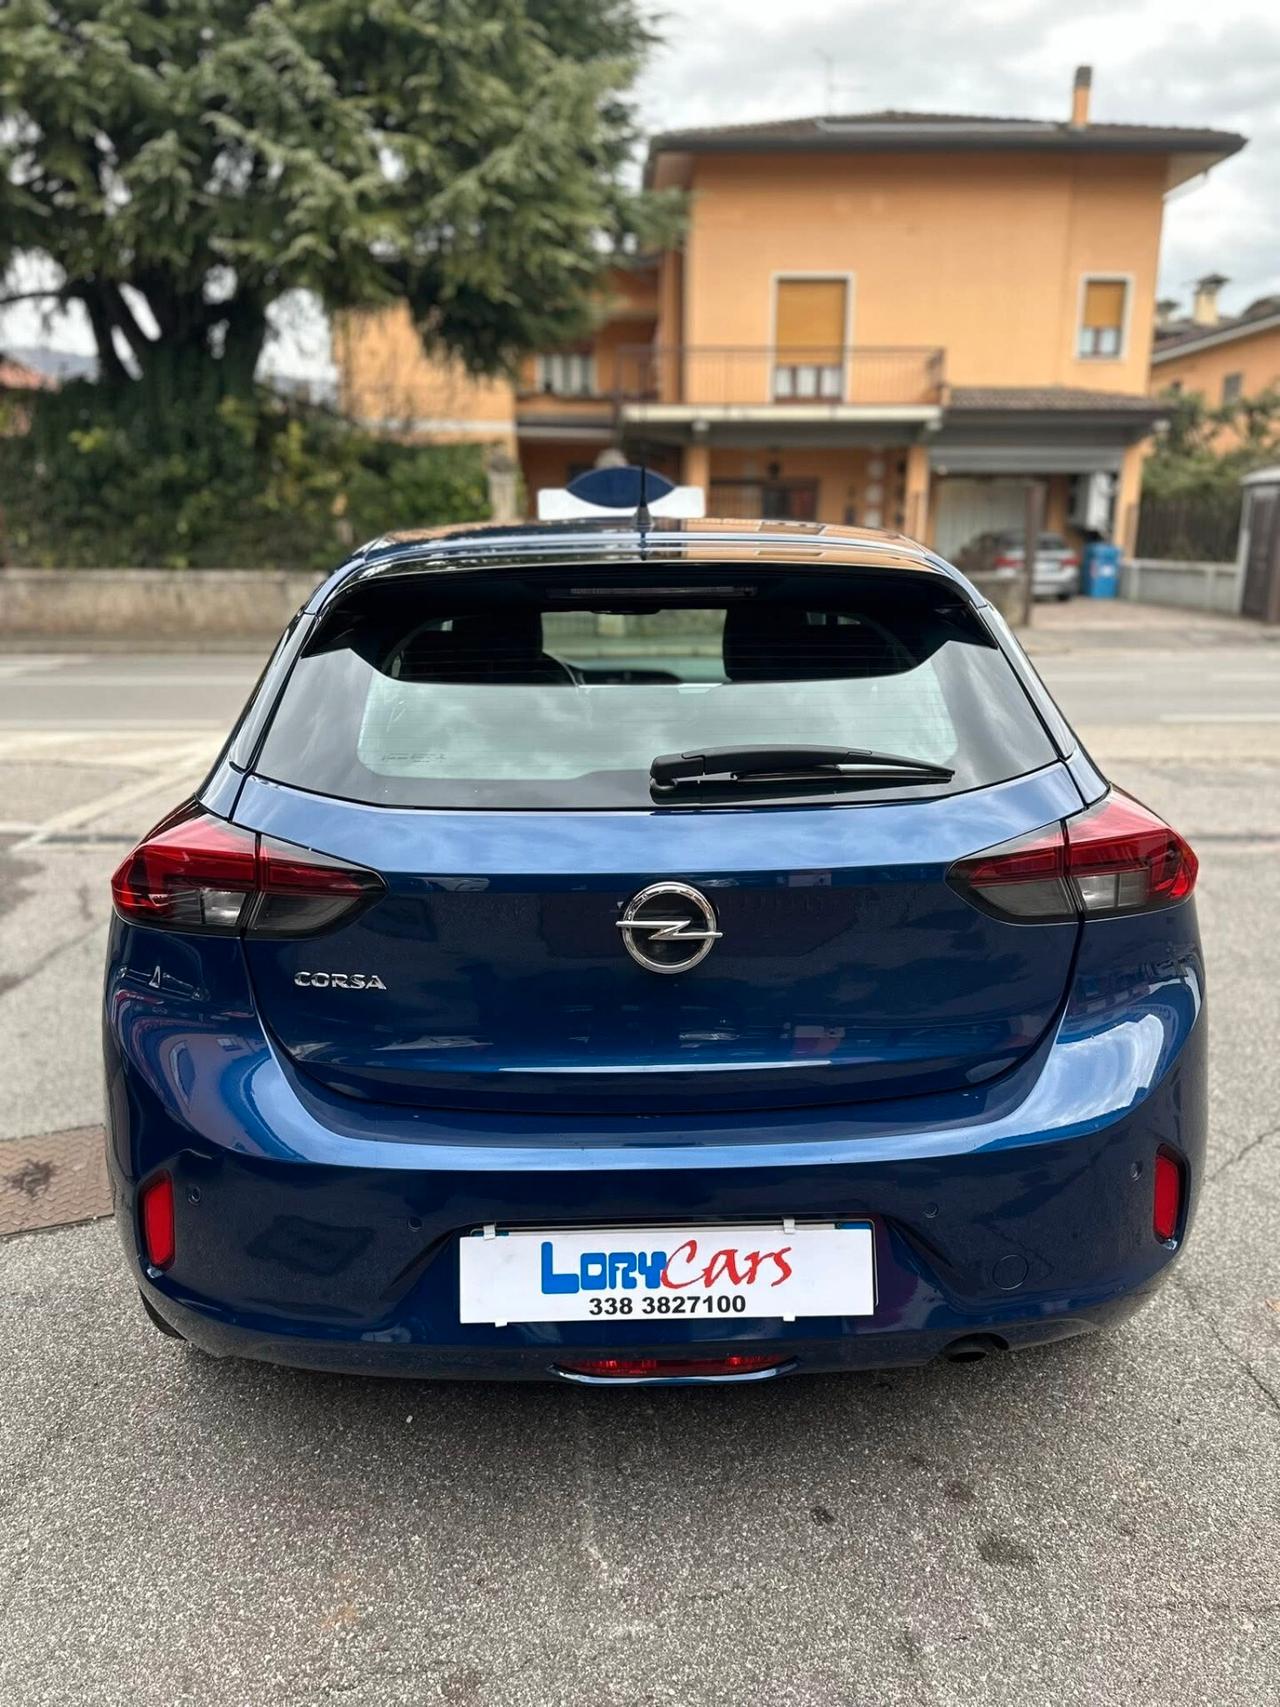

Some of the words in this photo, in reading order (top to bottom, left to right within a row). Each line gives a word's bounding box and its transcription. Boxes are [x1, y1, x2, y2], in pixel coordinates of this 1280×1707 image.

[294, 971, 387, 990] CORSA
[589, 1297, 633, 1315] 338
[641, 1295, 746, 1314] 3827100
